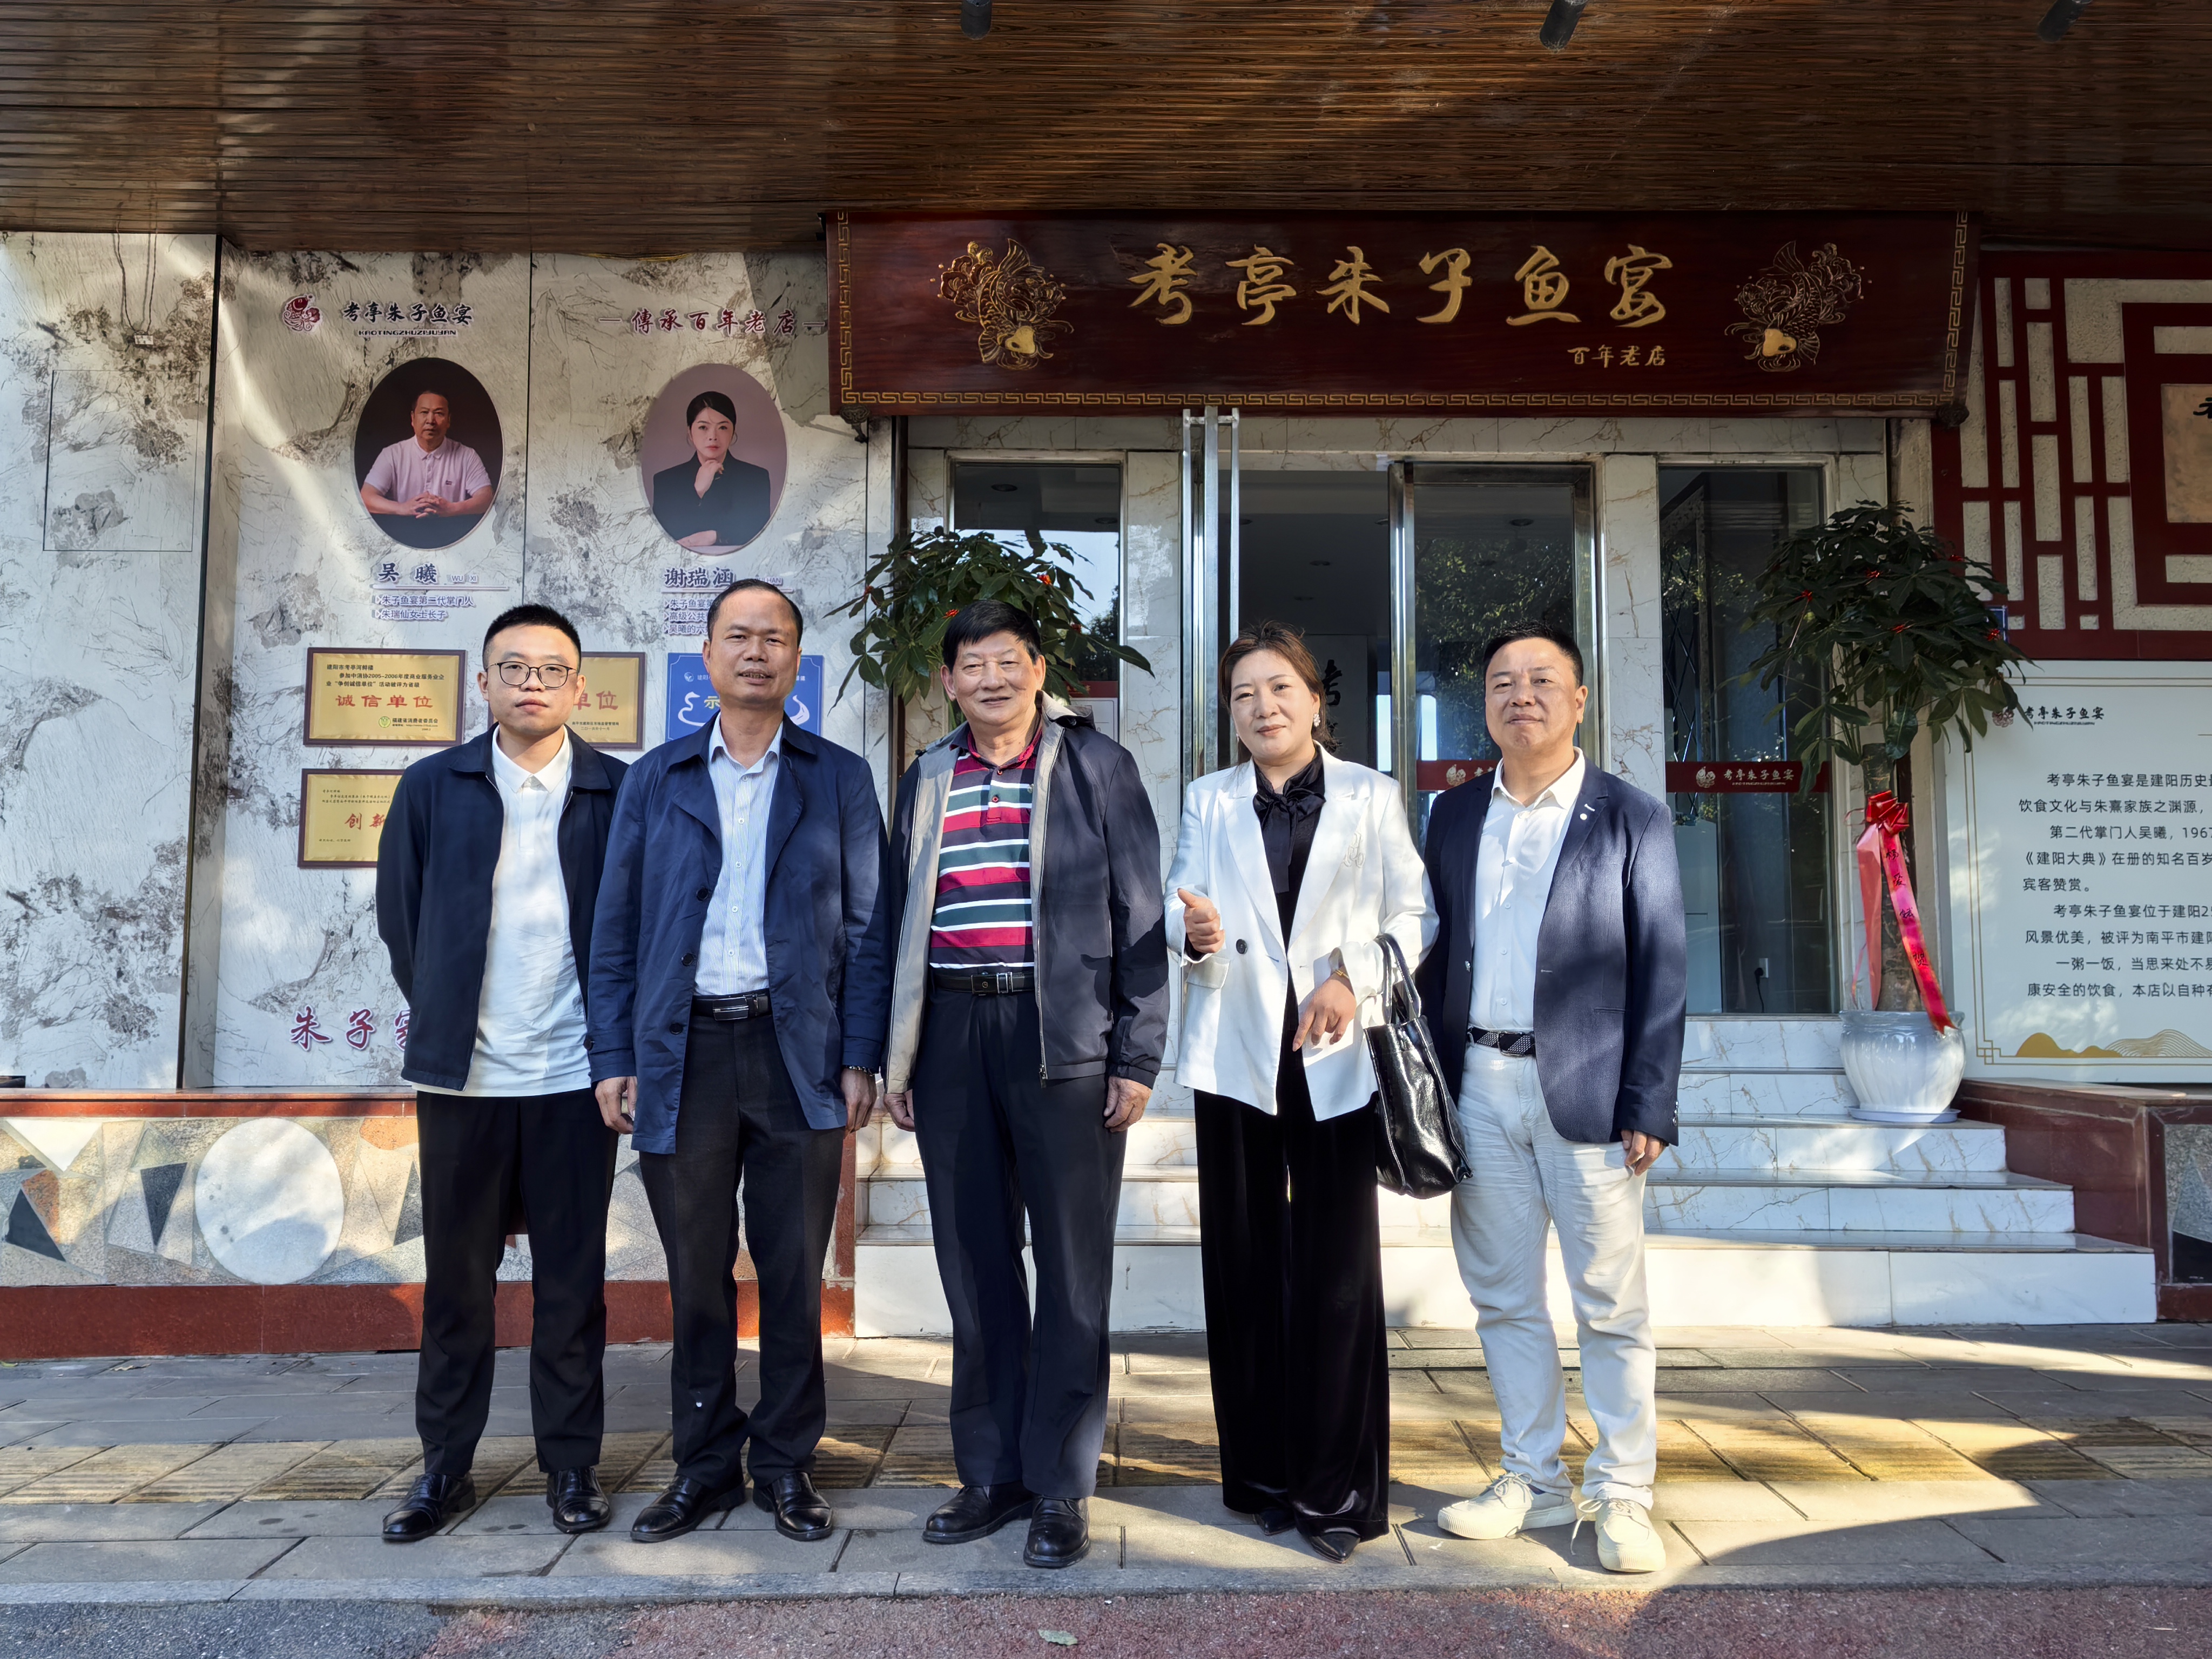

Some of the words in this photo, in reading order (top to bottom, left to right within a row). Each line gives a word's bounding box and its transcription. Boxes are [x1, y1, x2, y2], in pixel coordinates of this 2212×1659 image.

[1127, 243, 1673, 328] 考亭朱子鱼宴
[344, 301, 473, 325] 考亭朱子鱼宴
[632, 309, 795, 335] 傳承百年老店
[1567, 344, 1666, 368] 百年老店
[378, 563, 437, 582] 吴曦
[664, 567, 733, 587] 谢瑞涵
[381, 609, 446, 619] 朱瑞仙女士长子
[669, 611, 708, 621] 高级公共
[669, 624, 707, 633] 吴曦的六
[335, 694, 433, 708] 诚信单位
[704, 696, 720, 709] 示
[2024, 706, 2105, 720] 考亭朱子鱼宴
[1723, 768, 1795, 781] 考亭朱子鱼宴
[2047, 773, 2212, 787] 考亭朱子鱼宴是建阳历史
[2023, 878, 2089, 892] 宾客赞赏。
[2053, 903, 2212, 918] 考亭朱子鱼宴位于建阳2
